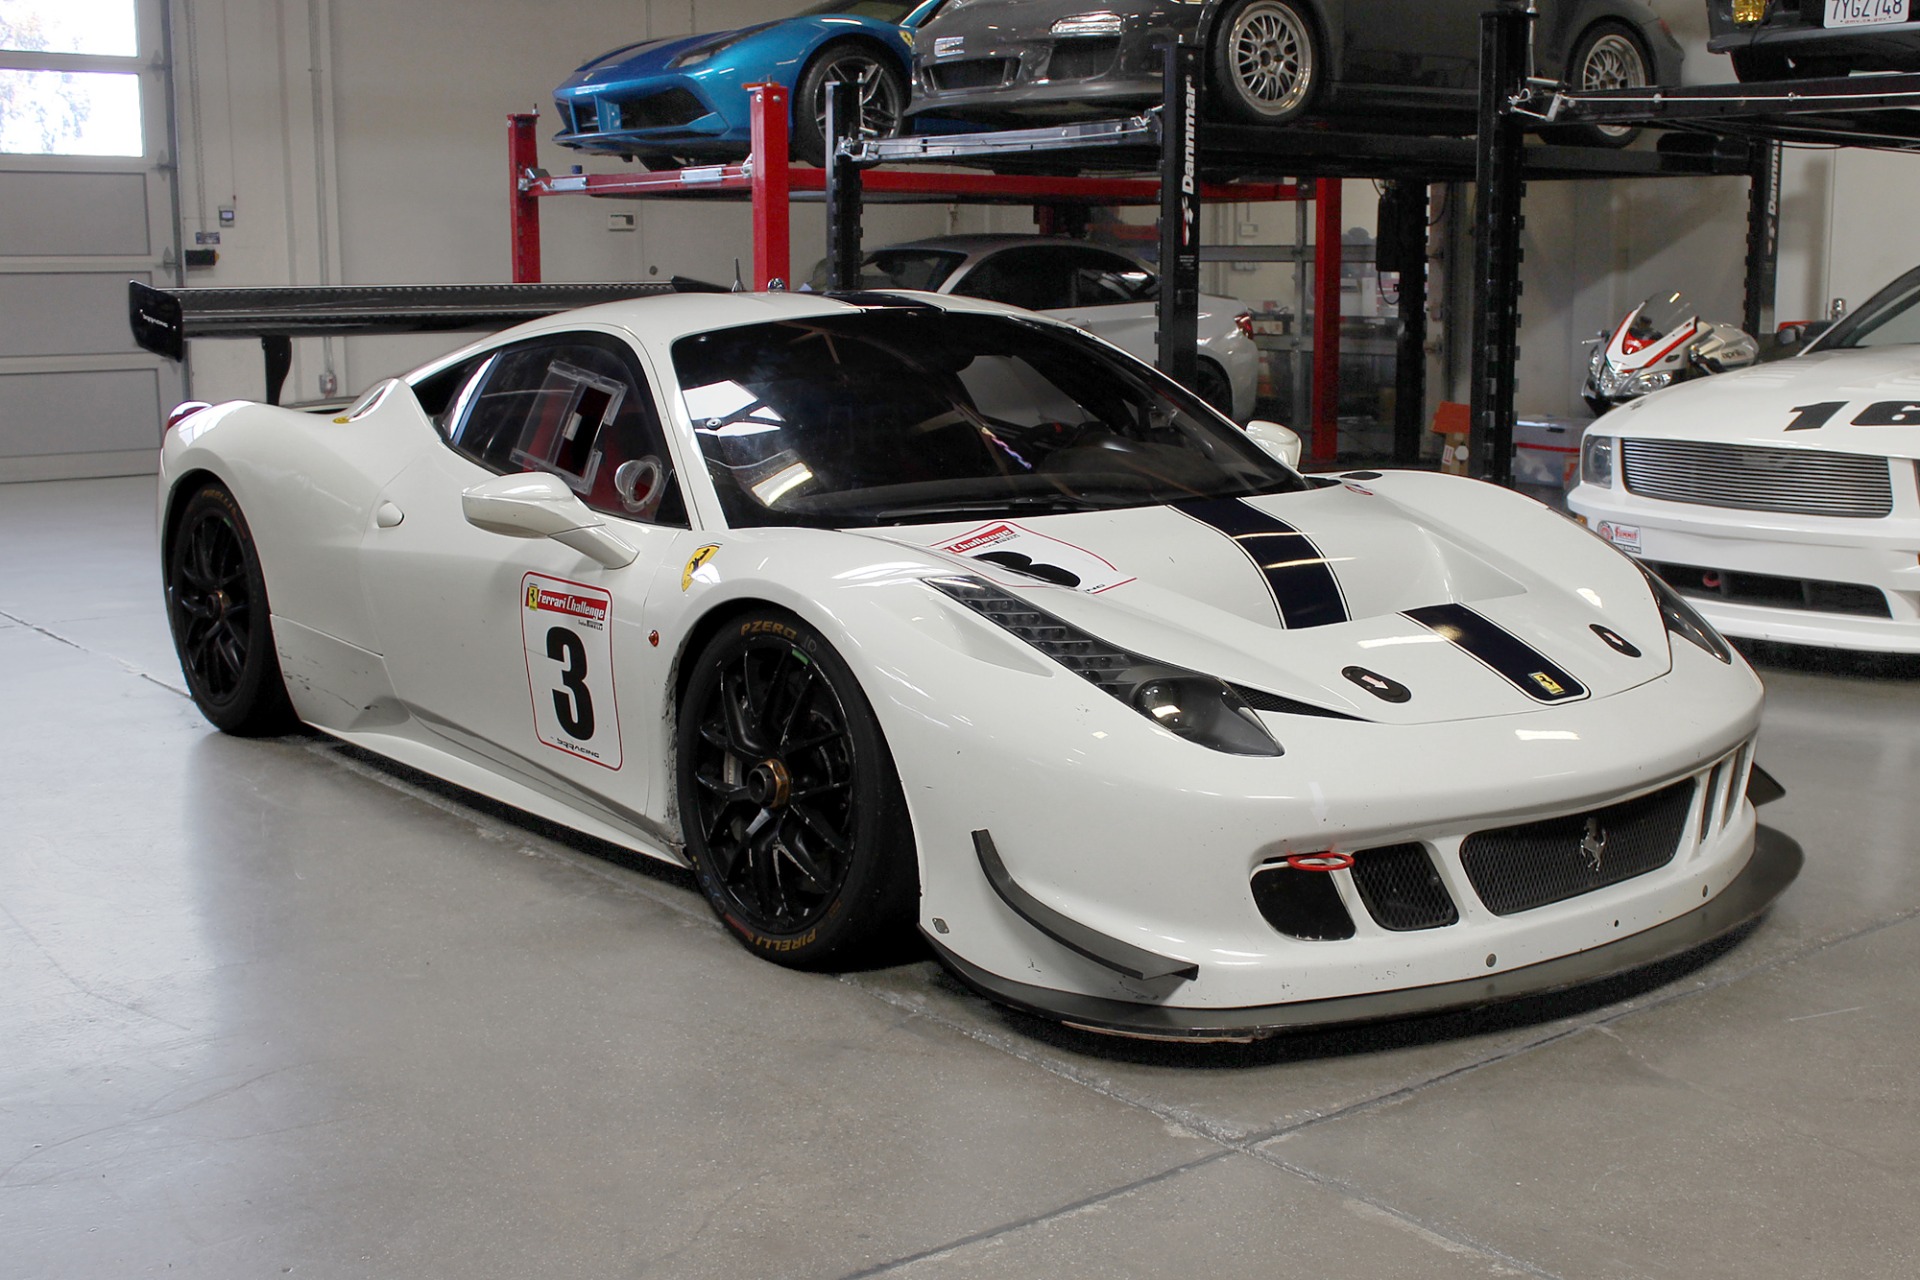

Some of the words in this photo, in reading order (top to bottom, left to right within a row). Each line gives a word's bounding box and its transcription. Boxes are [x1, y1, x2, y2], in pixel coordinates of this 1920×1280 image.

[1182, 86, 1196, 195] Dannmar
[537, 589, 567, 609] Ferrari
[566, 595, 605, 620] Challenge
[546, 626, 595, 741] 3
[756, 928, 817, 951] PIRELLI
